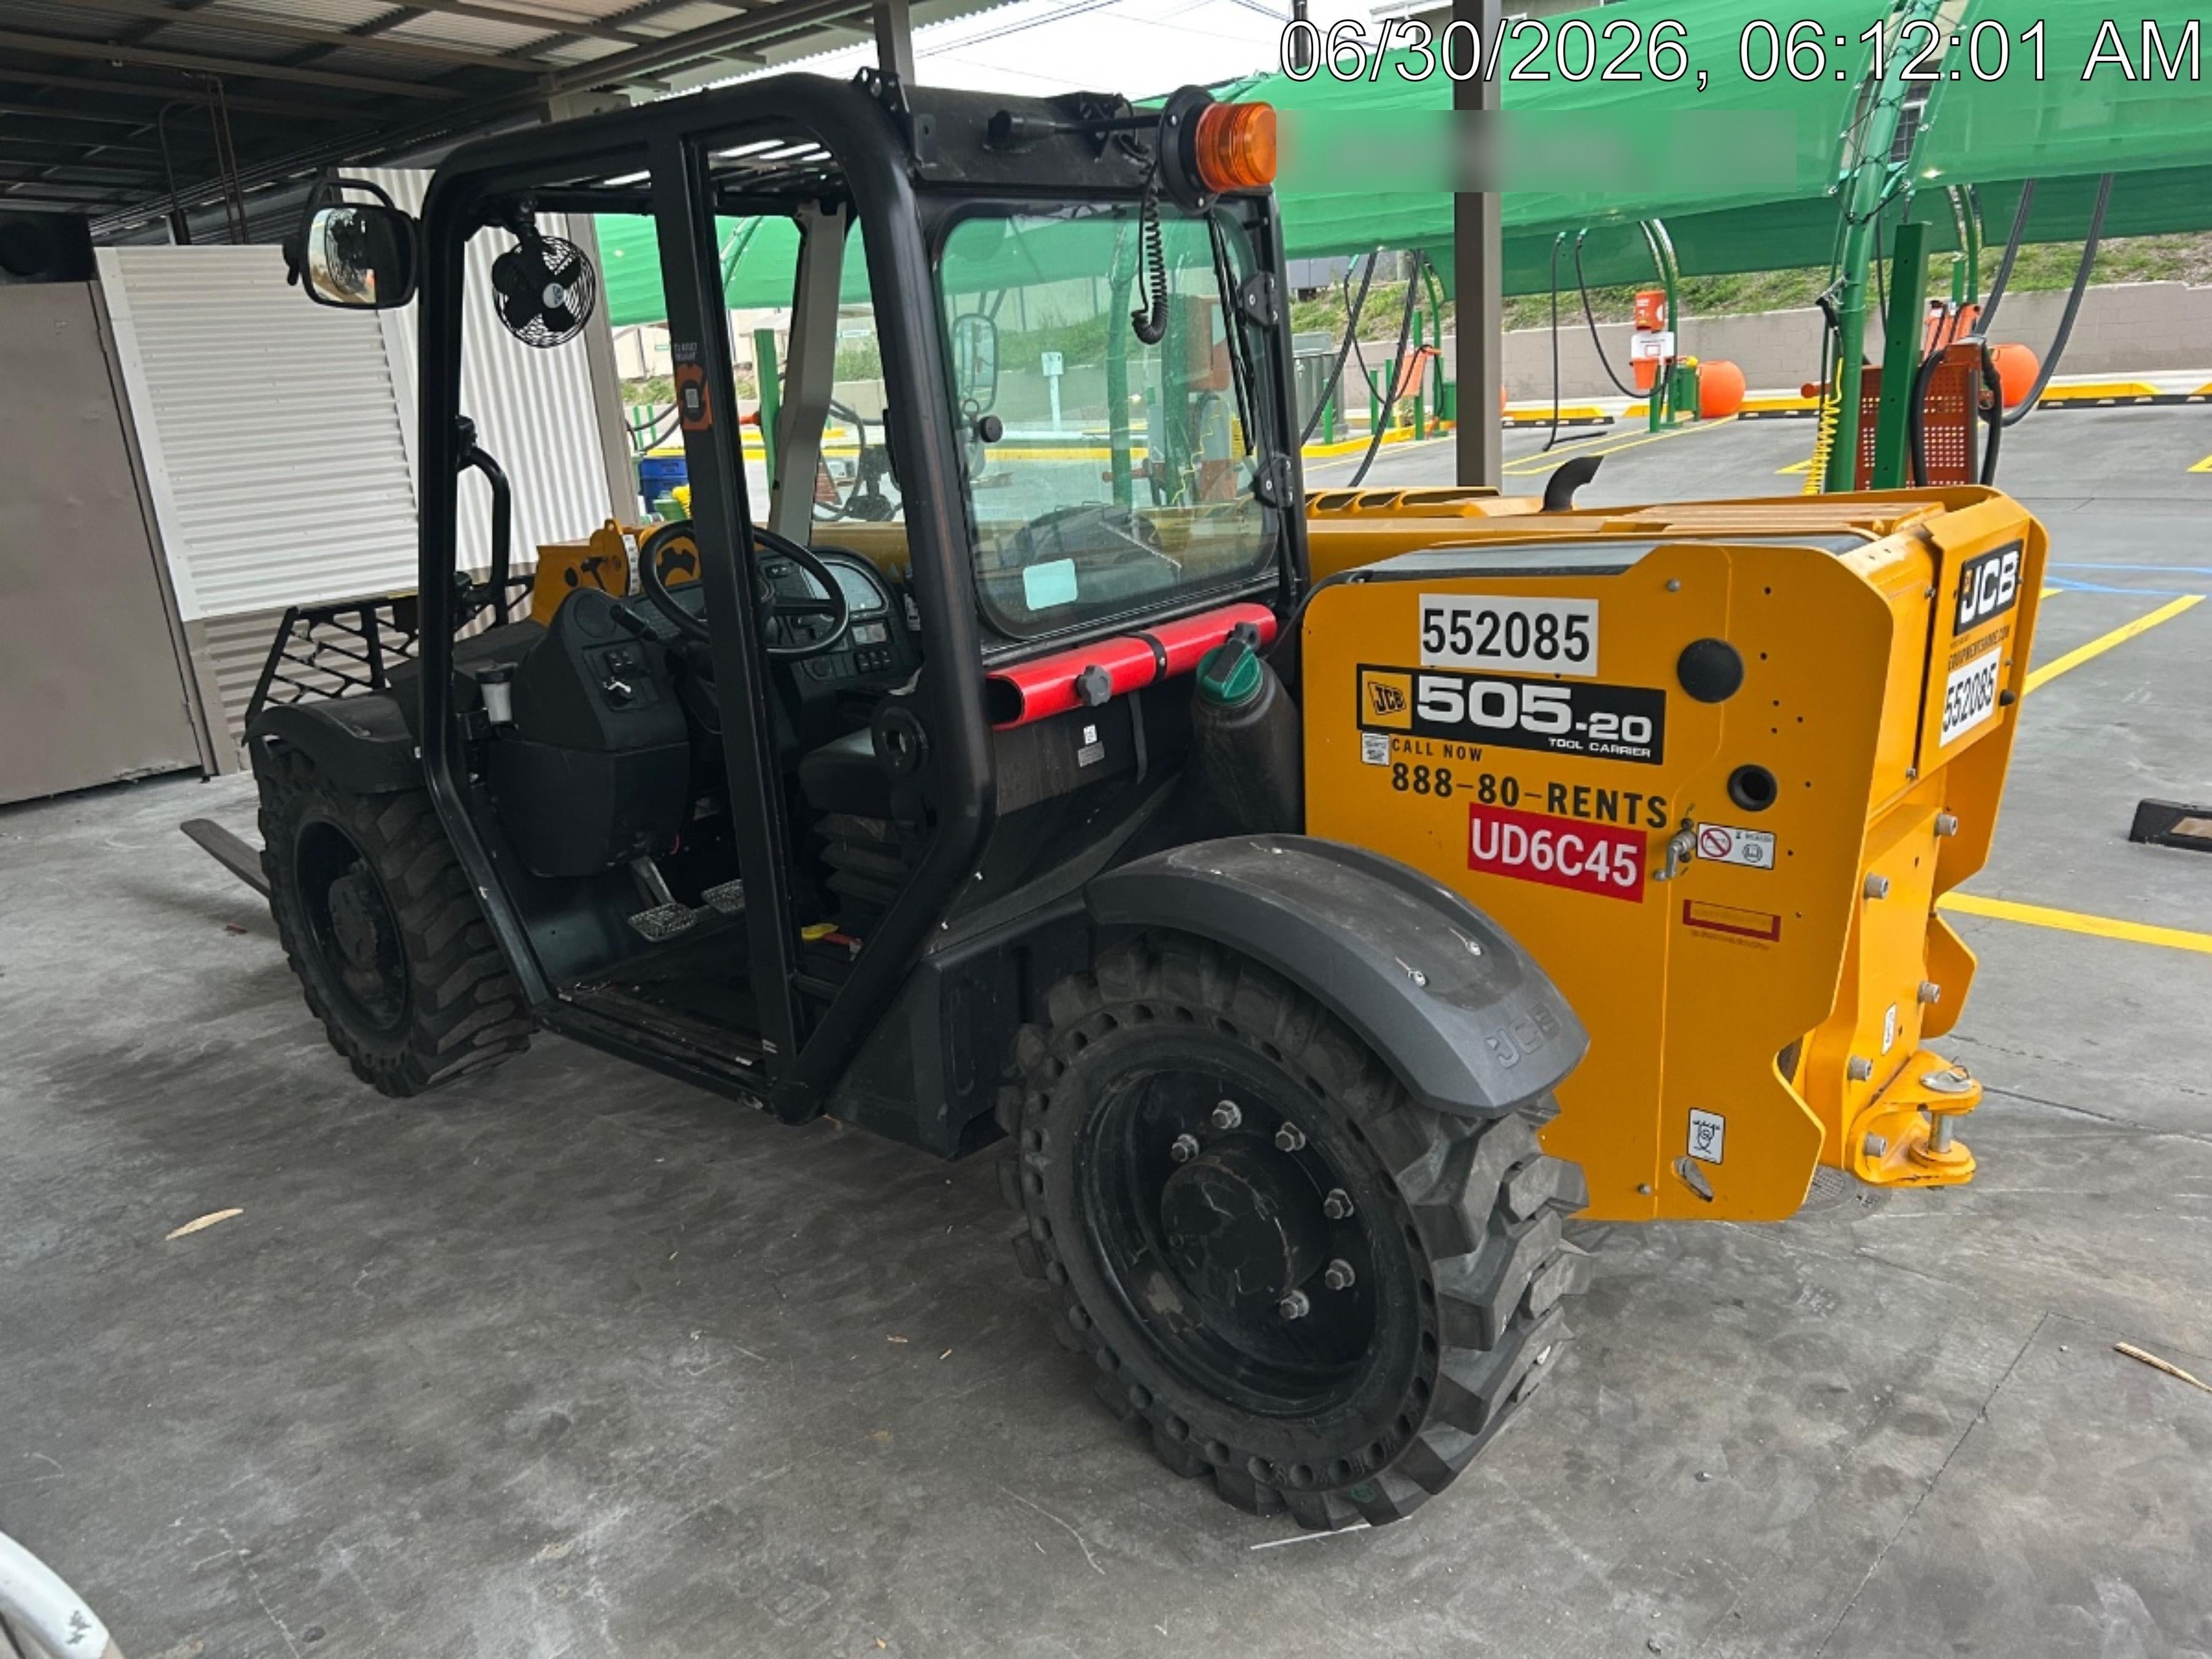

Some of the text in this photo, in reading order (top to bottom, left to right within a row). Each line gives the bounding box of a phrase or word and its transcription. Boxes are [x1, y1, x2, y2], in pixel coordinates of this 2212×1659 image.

[1960, 551, 2019, 624] JCB
[1422, 608, 1590, 662] 552085
[1369, 681, 1406, 715] JCB
[1942, 662, 1997, 732] 552085
[1392, 738, 1434, 756] CALL
[1443, 743, 1483, 763] NOW
[1548, 737, 1652, 758] TOOL CARRIER
[1391, 762, 1668, 828] 888-80-RENTS
[1472, 818, 1638, 888] UD6C45
[1484, 1002, 1561, 1070] JCB
